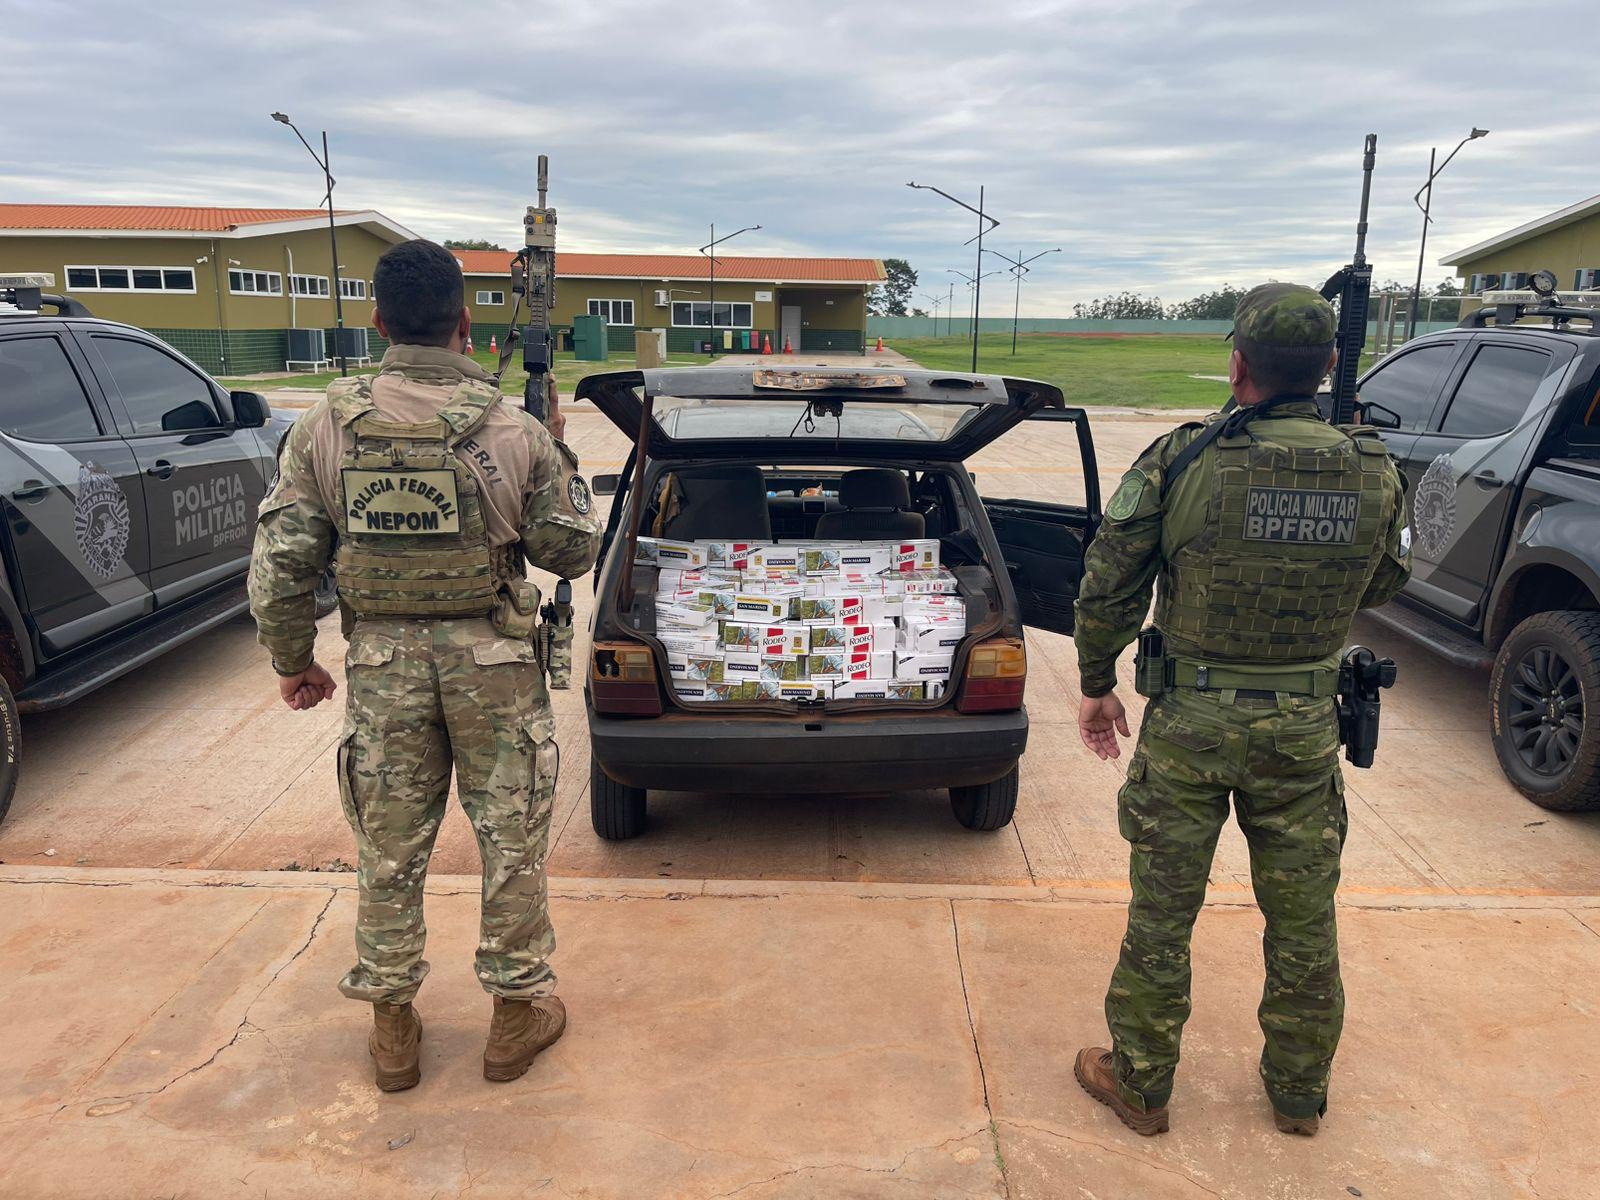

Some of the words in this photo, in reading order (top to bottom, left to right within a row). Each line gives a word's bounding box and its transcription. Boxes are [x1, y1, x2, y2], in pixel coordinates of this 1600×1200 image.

[172, 473, 245, 517] POLÍCIA
[350, 478, 395, 520] POLICIA
[400, 478, 456, 520] FEDERAL
[1249, 491, 1300, 517] POLÍCIA
[1304, 495, 1357, 519] MILITAR
[175, 499, 247, 546] MILITAR
[366, 511, 439, 530] NEPOM
[1246, 516, 1355, 542] BPFRON
[213, 524, 247, 548] BPFRON
[730, 553, 746, 561] RODE
[896, 552, 918, 562] RODEO
[839, 606, 863, 617] RODEO
[762, 636, 787, 646] RODEO
[850, 634, 873, 645] RODEO
[847, 662, 871, 672] RODEO
